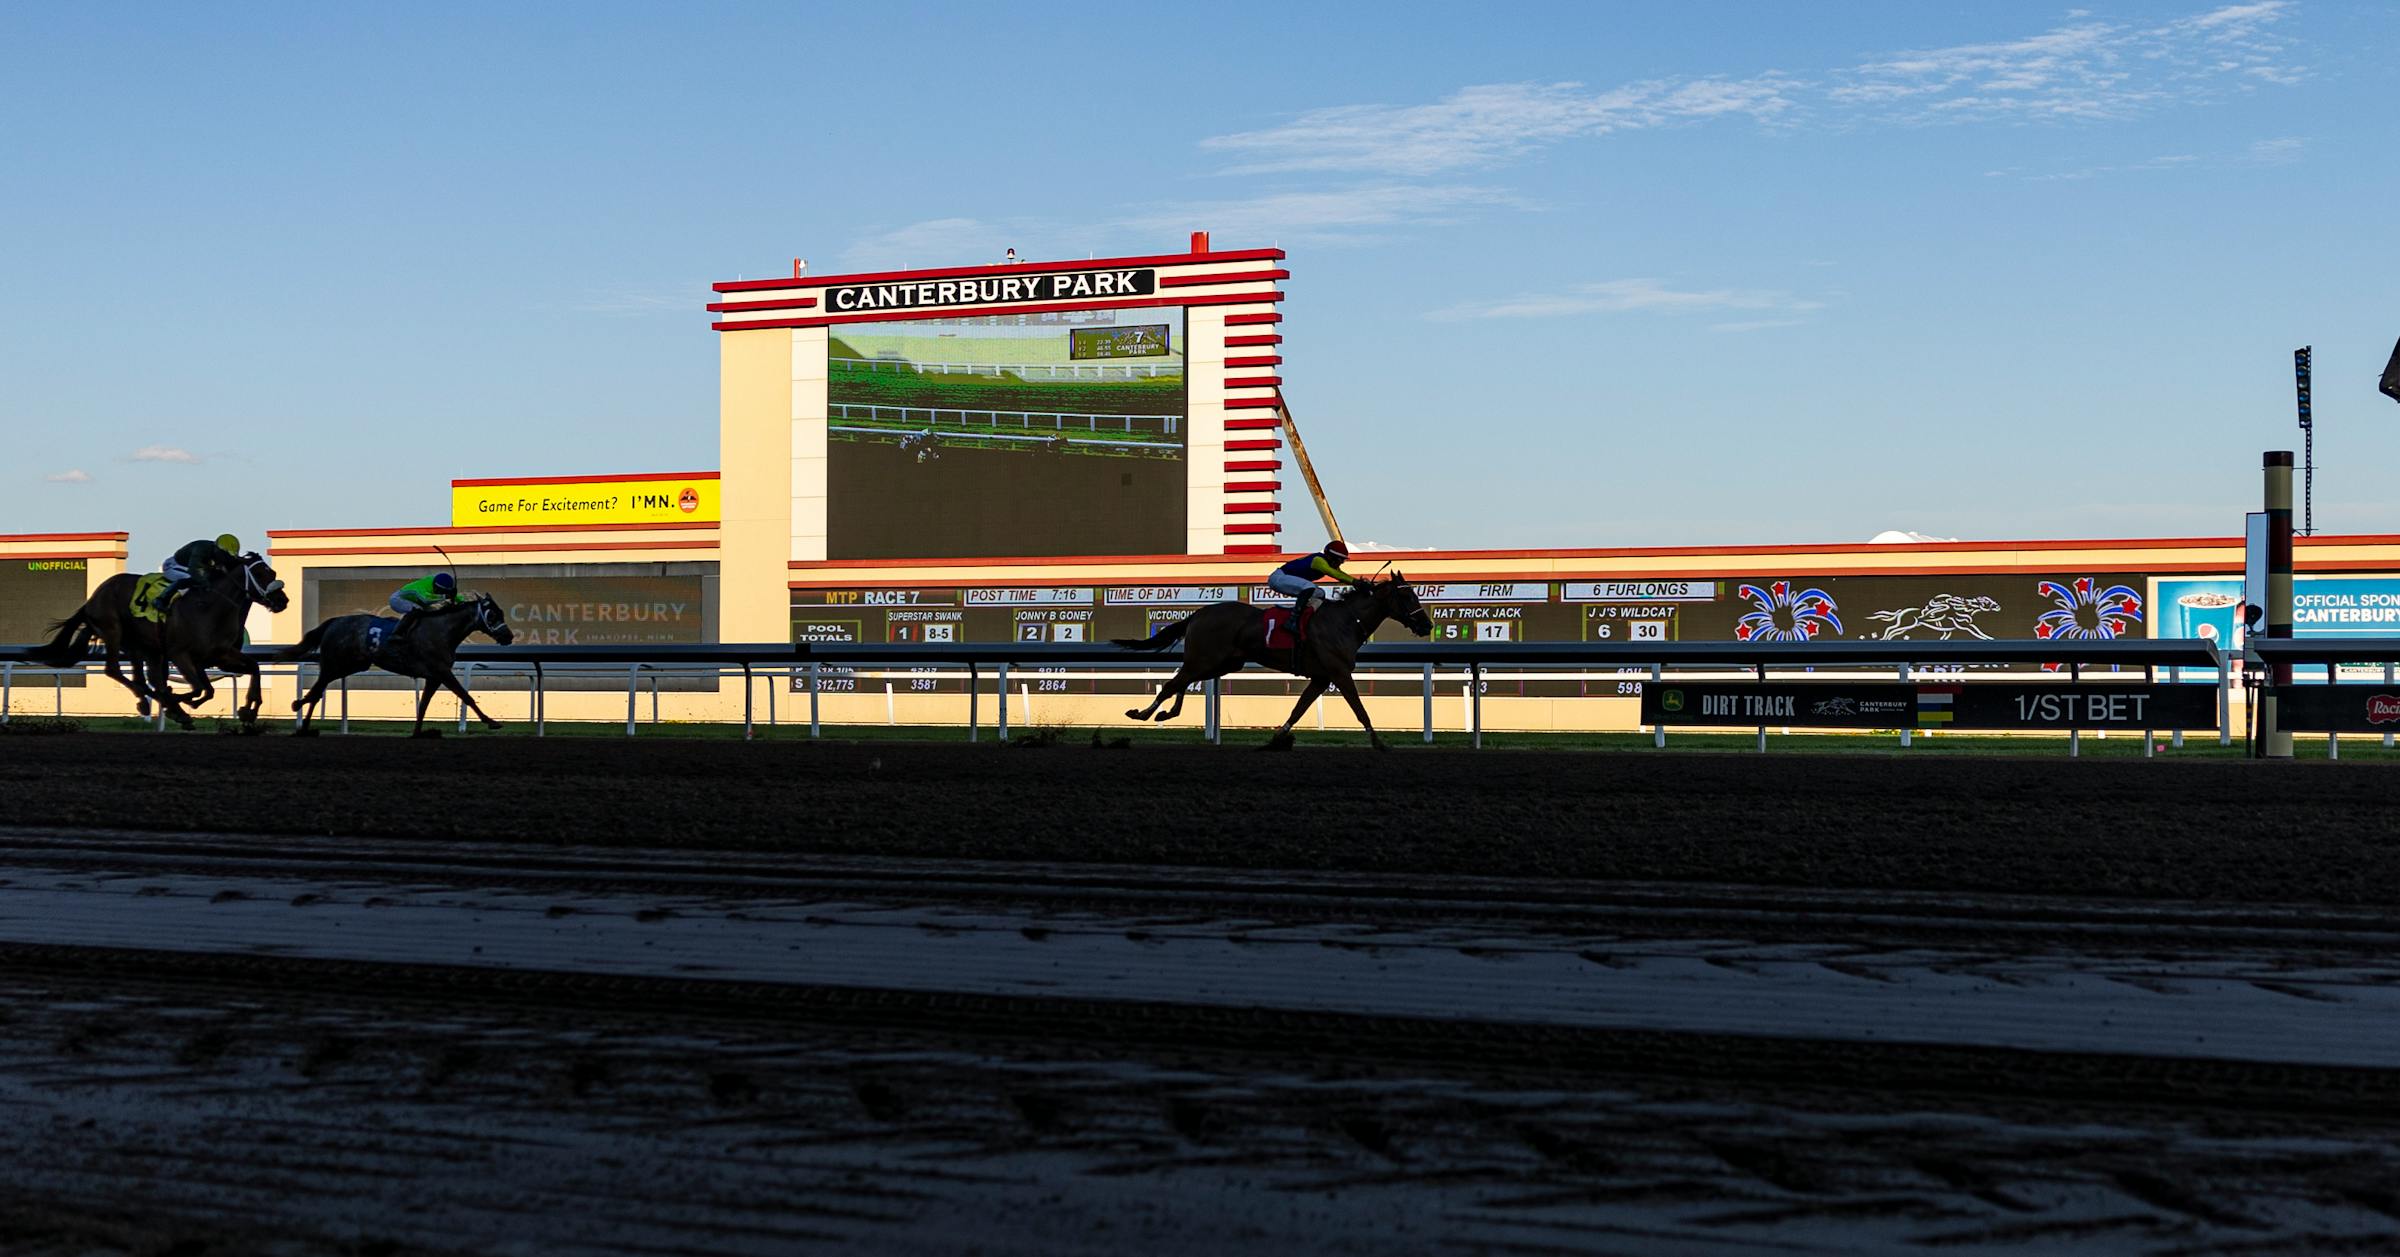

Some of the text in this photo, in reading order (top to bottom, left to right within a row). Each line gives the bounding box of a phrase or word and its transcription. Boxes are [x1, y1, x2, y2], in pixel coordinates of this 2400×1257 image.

[836, 271, 1138, 309] CANTERBURY PARK
[479, 497, 618, 513] Game For Excitement?
[28, 561, 86, 571] UNOFFICIAL
[971, 589, 1077, 601] POST TIME 7:16
[1108, 588, 1224, 600] TIME OF DAY 7:19
[1479, 585, 1513, 597] FIRM
[1593, 583, 1689, 596] 6 FURLONGS
[135, 583, 151, 612] 4
[826, 591, 920, 604] MTP RACE 7
[2294, 595, 2357, 607] OFFICIAL
[510, 603, 686, 622] CANTERBURY
[888, 612, 962, 621] SUPERSTAR SWANK
[1015, 611, 1093, 620] JONNY B GONEY
[1433, 608, 1521, 618] HAT TRICK JACK
[1589, 607, 1674, 617] J J'S WILDCAT
[808, 625, 845, 633] POOL
[899, 628, 908, 640] 1
[929, 629, 948, 639] 8-5
[1027, 628, 1038, 640] 2
[1064, 628, 1072, 639] 2
[1266, 618, 1276, 647] 1
[1446, 625, 1458, 638] 5
[1485, 626, 1502, 637] 17
[1598, 624, 1611, 638] 6
[1638, 626, 1657, 637] 30
[368, 627, 382, 649] 3
[795, 678, 803, 688] S
[910, 679, 937, 690] 3581
[1039, 680, 1067, 690] 2864
[1617, 682, 1642, 693] 598
[1702, 695, 1795, 717] DIRT TRACK
[2015, 695, 2150, 720] 1/ST BET
